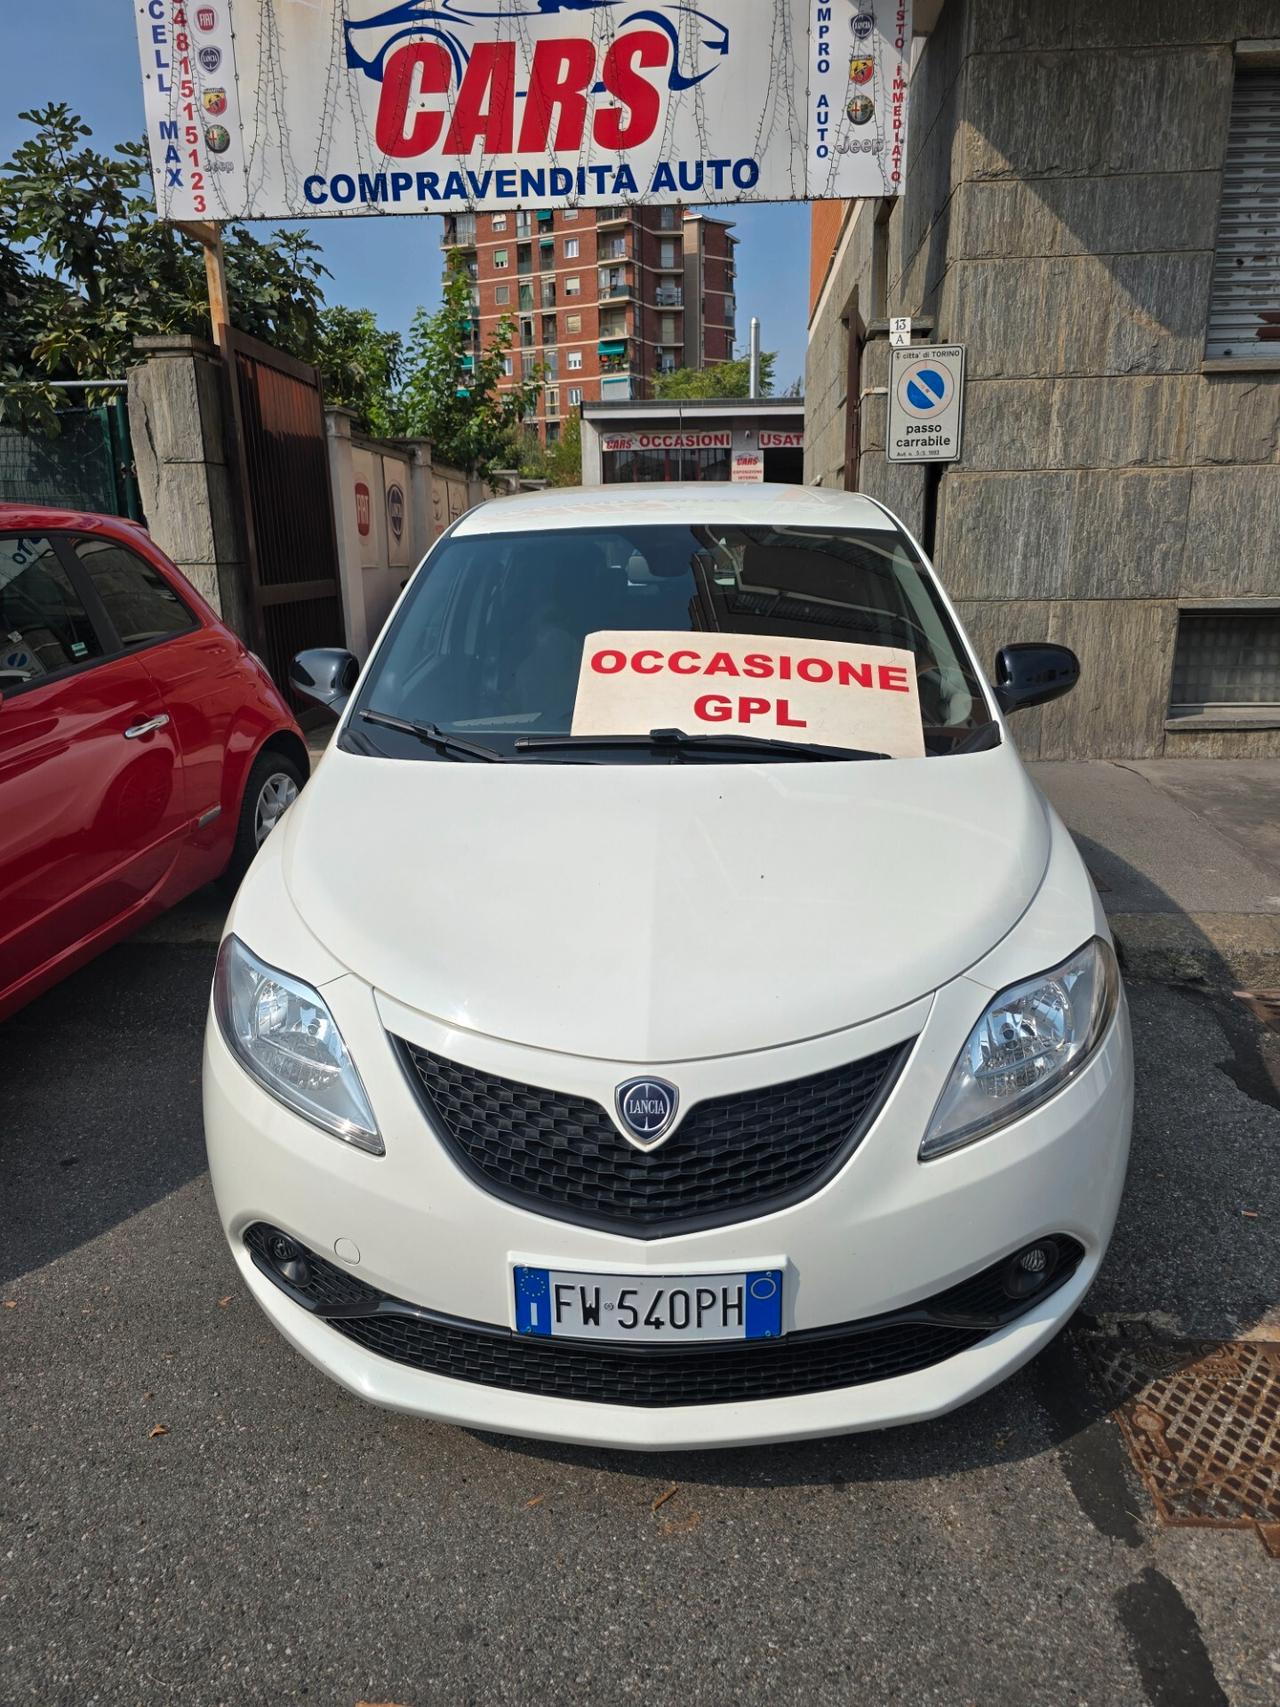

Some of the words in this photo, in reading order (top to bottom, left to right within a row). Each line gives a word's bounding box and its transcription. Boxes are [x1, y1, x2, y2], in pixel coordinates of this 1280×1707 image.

[173, 0, 207, 213] 481515123
[375, 30, 669, 158] CARS
[816, 94, 830, 159] AUTO
[891, 65, 904, 182] IMMEDIATO
[159, 121, 184, 187] MAX
[834, 135, 884, 156] Jeep
[303, 164, 638, 204] COMPRAVENDITA
[650, 158, 759, 192] AUTO
[894, 319, 907, 331] 13
[895, 334, 905, 345] A
[931, 350, 960, 358] TORINO
[606, 439, 632, 450] CARS
[639, 433, 731, 448] OCCASIONI
[896, 435, 951, 448] carrabile
[906, 424, 942, 436] passo
[736, 457, 759, 466] CARS
[590, 650, 910, 692] OCCASIONE
[693, 694, 807, 728] GPL
[629, 1100, 666, 1115] LANCIA
[554, 1284, 600, 1327] FW
[617, 1286, 743, 1330] 540PH
